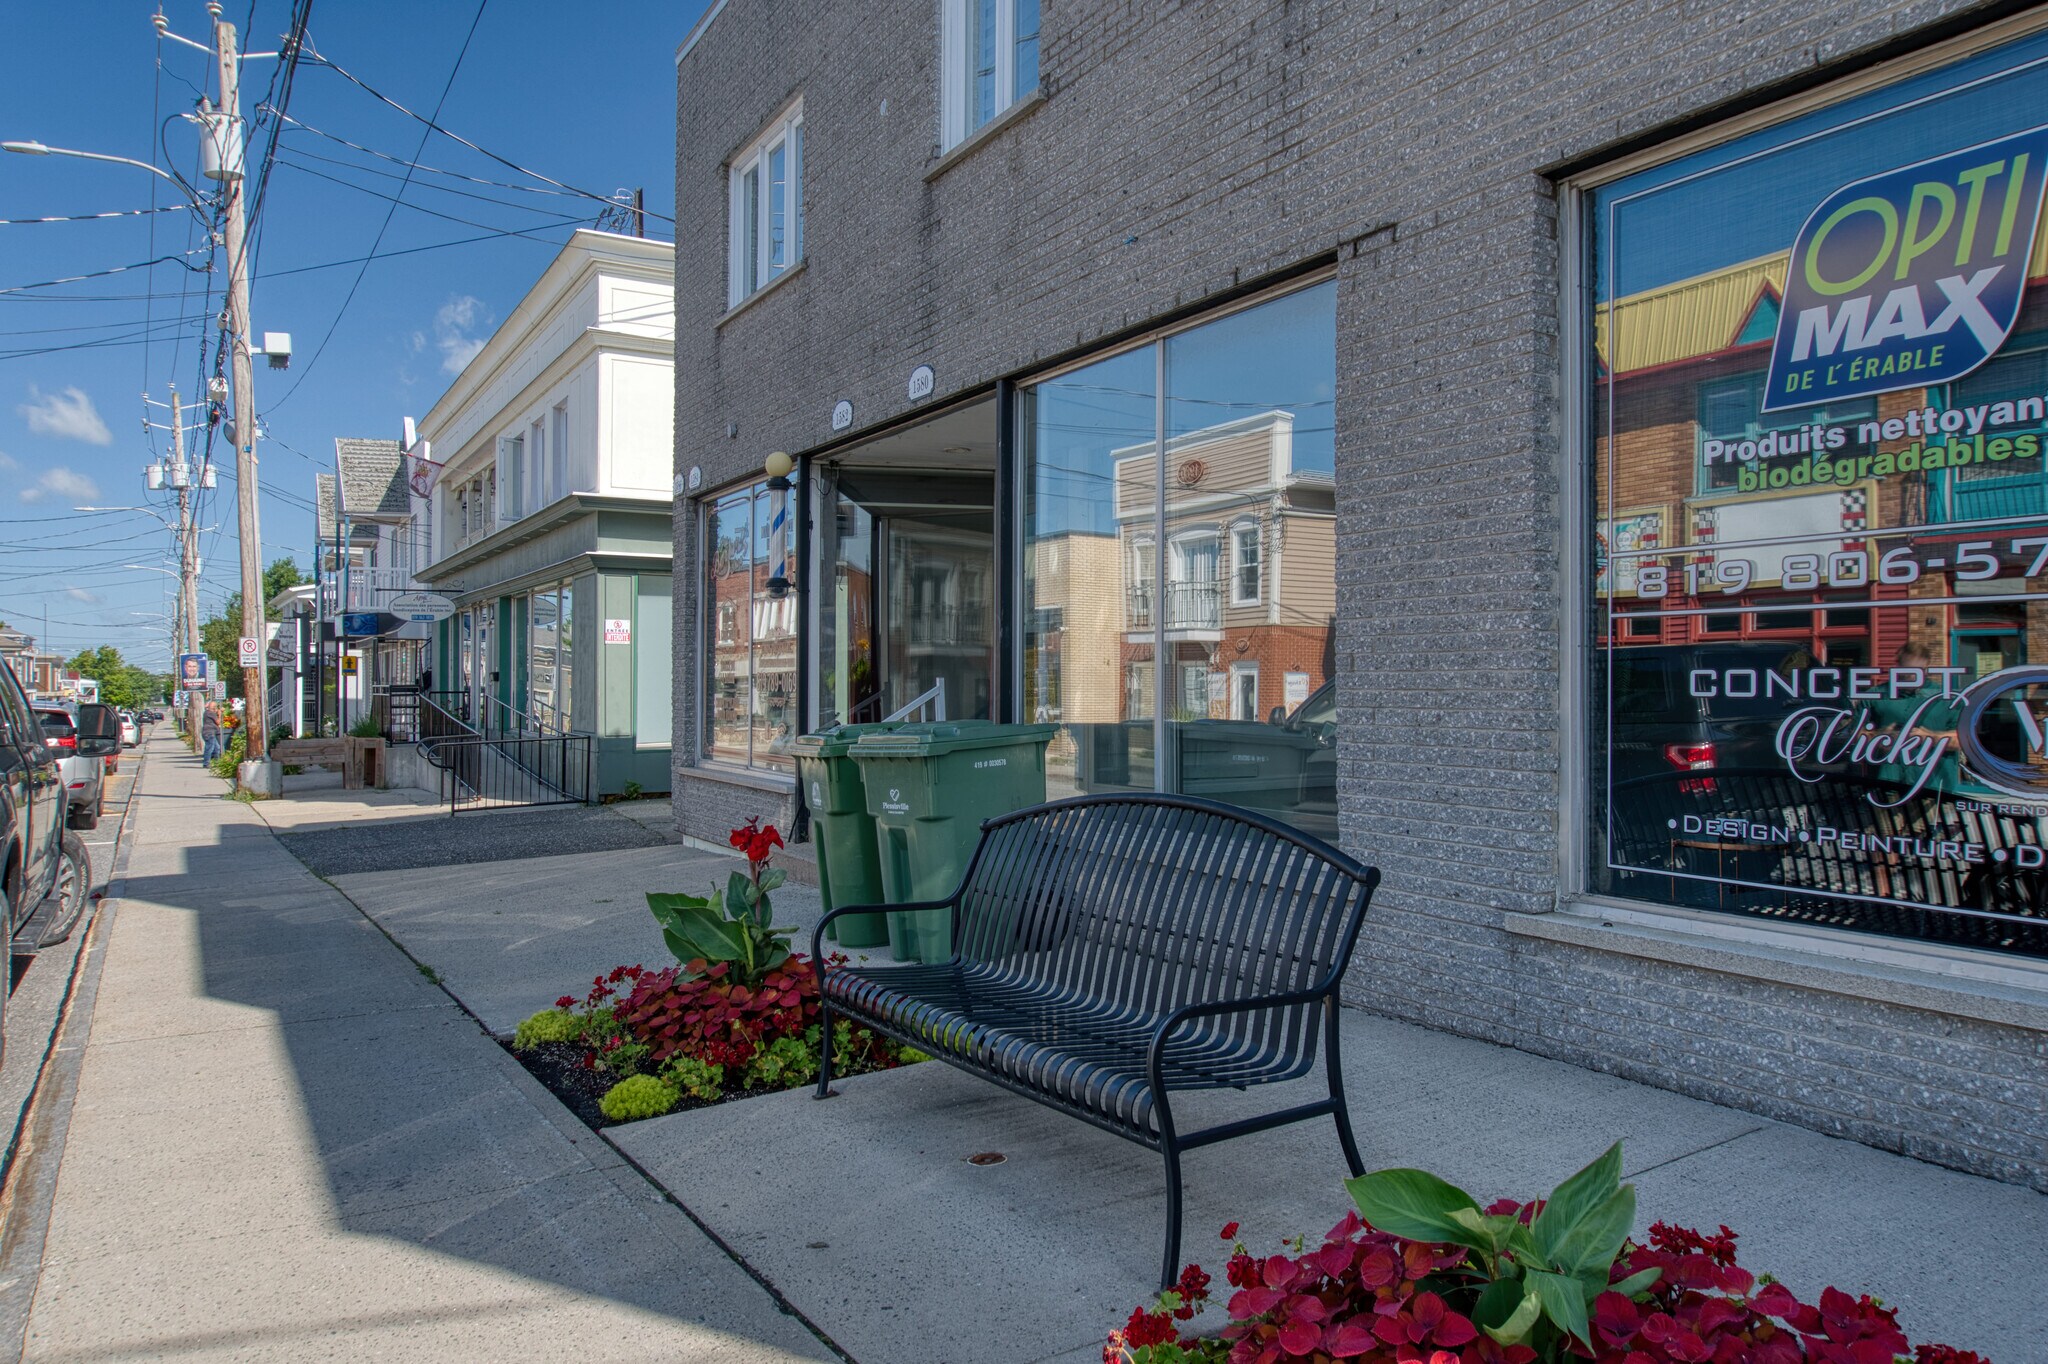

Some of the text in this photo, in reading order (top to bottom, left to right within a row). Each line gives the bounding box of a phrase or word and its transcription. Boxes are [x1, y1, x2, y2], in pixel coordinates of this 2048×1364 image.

[1805, 153, 2030, 296] OPTI
[1791, 265, 2006, 363] MAX
[913, 374, 929, 394] 1580
[1785, 369, 1815, 393] DE
[1703, 395, 2048, 467] Produits nettoyan
[1738, 434, 2038, 492] biodégradables
[1637, 536, 2048, 599] 819 806-57
[1690, 667, 1967, 699] CONCEPT
[1775, 692, 1970, 808] Vicky
[1956, 801, 1991, 813] SUR
[1684, 815, 1791, 843] DESIGN
[1817, 827, 1985, 863] PEINTURE
